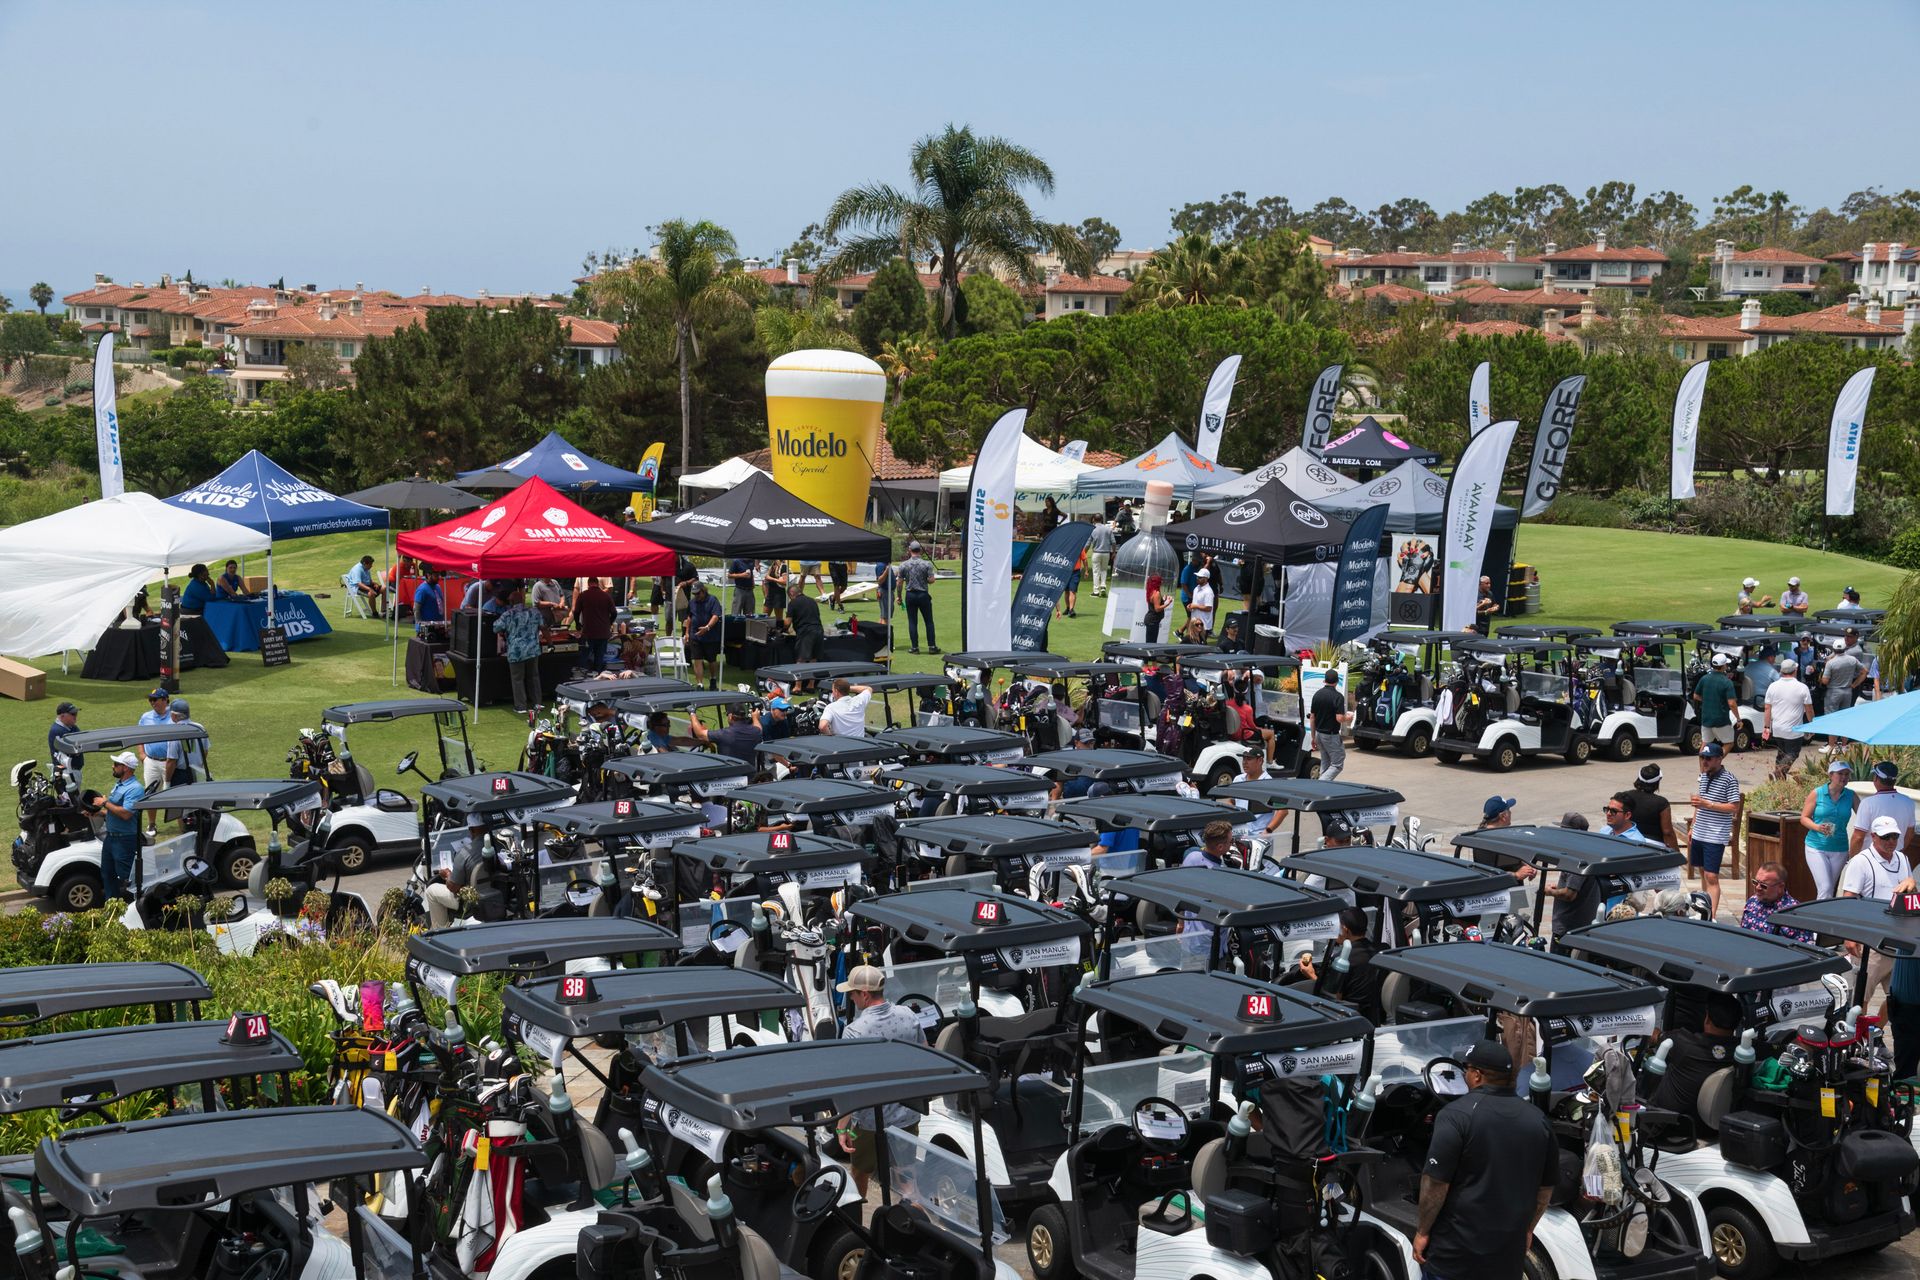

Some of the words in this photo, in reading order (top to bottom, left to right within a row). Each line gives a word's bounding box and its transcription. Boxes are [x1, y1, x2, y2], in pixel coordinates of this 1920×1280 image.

[1307, 378, 1339, 460] /FORE
[794, 424, 822, 432] CERVEZA
[777, 429, 847, 458] Modelo
[1535, 389, 1580, 502] G/FORE
[791, 461, 829, 477] Especial
[200, 477, 258, 499] Miracles
[187, 492, 250, 508] KIDS
[288, 491, 336, 505] KIDS
[293, 517, 373, 533] www.miraclesforkids.org
[524, 528, 555, 538] SAN
[554, 527, 612, 539] MANUEL
[1352, 539, 1375, 551] Modelo
[1042, 552, 1069, 567] Modelo
[1349, 560, 1371, 570] Modelo
[1034, 572, 1061, 587] Modelo
[1027, 593, 1054, 608] Modelo
[1020, 614, 1044, 627] Model
[1013, 634, 1035, 648] Modelo
[495, 779, 507, 790] 5A
[617, 801, 630, 814] 5B
[668, 829, 691, 837] MANUEL
[774, 834, 788, 848] 4A
[825, 869, 850, 877] MANUEL
[1482, 895, 1507, 904] MANUEL
[979, 903, 997, 919] 4B
[1308, 920, 1334, 928] MANUEL
[1026, 948, 1040, 956] SAN
[1041, 946, 1070, 954] MANUEL
[565, 978, 585, 997] 3B
[1249, 996, 1269, 1015] 3A
[1794, 1000, 1808, 1009] SAN
[1808, 997, 1833, 1007] MANUE
[1596, 1016, 1613, 1024] SAN
[1614, 1014, 1647, 1022] MANUEL
[248, 1017, 266, 1038] 2A
[1245, 1060, 1263, 1069] PENTA
[1300, 1056, 1320, 1065] SAN
[1321, 1053, 1356, 1063] MANUEL
[681, 1116, 695, 1128] SAN
